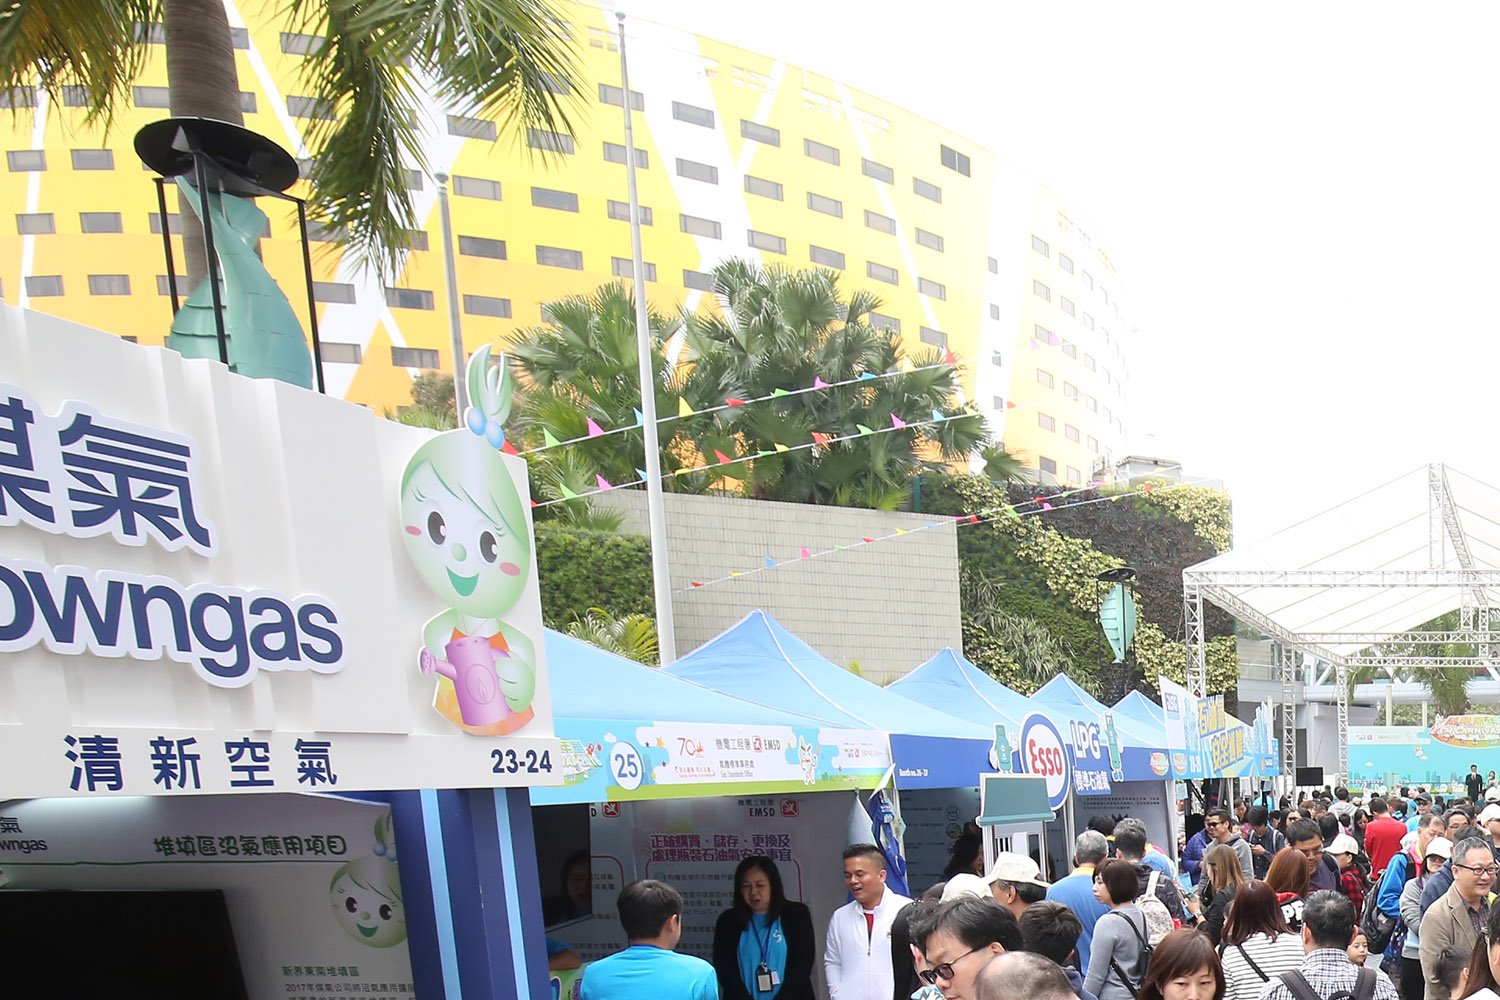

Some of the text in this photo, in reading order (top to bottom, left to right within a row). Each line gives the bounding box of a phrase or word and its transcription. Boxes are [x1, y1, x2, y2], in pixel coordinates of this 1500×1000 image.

[764, 739, 781, 751] EMSD
[64, 734, 338, 792] 清新空氣
[490, 749, 553, 774] 23-24
[614, 753, 639, 778] 25
[749, 808, 776, 817] EMSD
[154, 835, 347, 856] 堆填區沼氣應用項目
